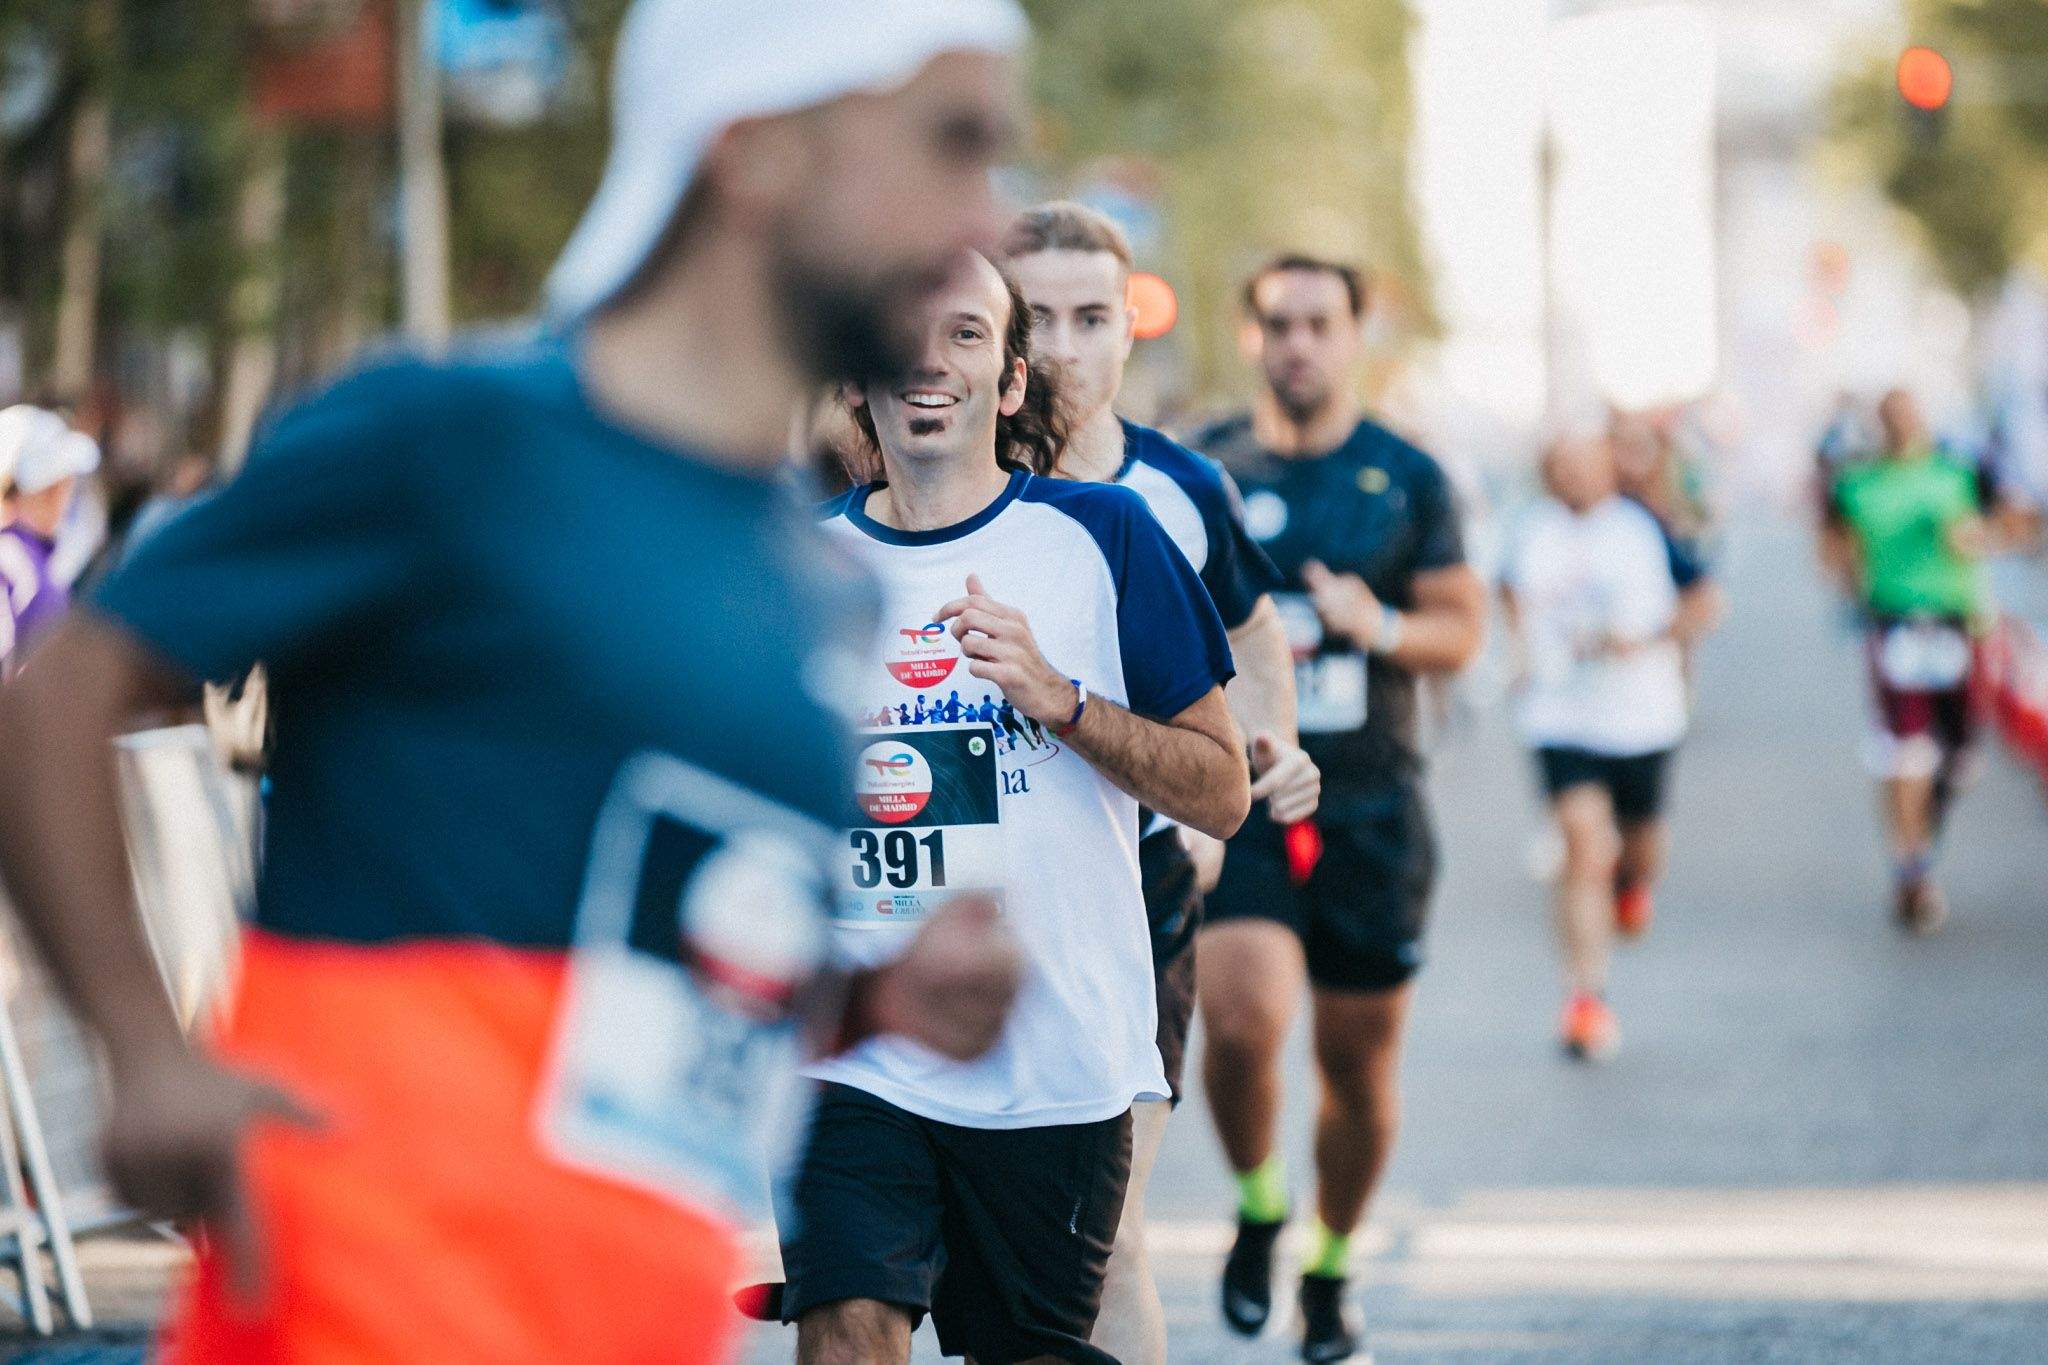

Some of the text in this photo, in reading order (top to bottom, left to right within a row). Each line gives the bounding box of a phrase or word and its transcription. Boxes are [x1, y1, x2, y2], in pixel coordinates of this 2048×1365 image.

[910, 662, 937, 670] MILLA
[901, 668, 948, 680] DE MADRID
[878, 794, 907, 803] MILLA
[869, 803, 918, 812] DE MADRID
[850, 829, 946, 888] 391
